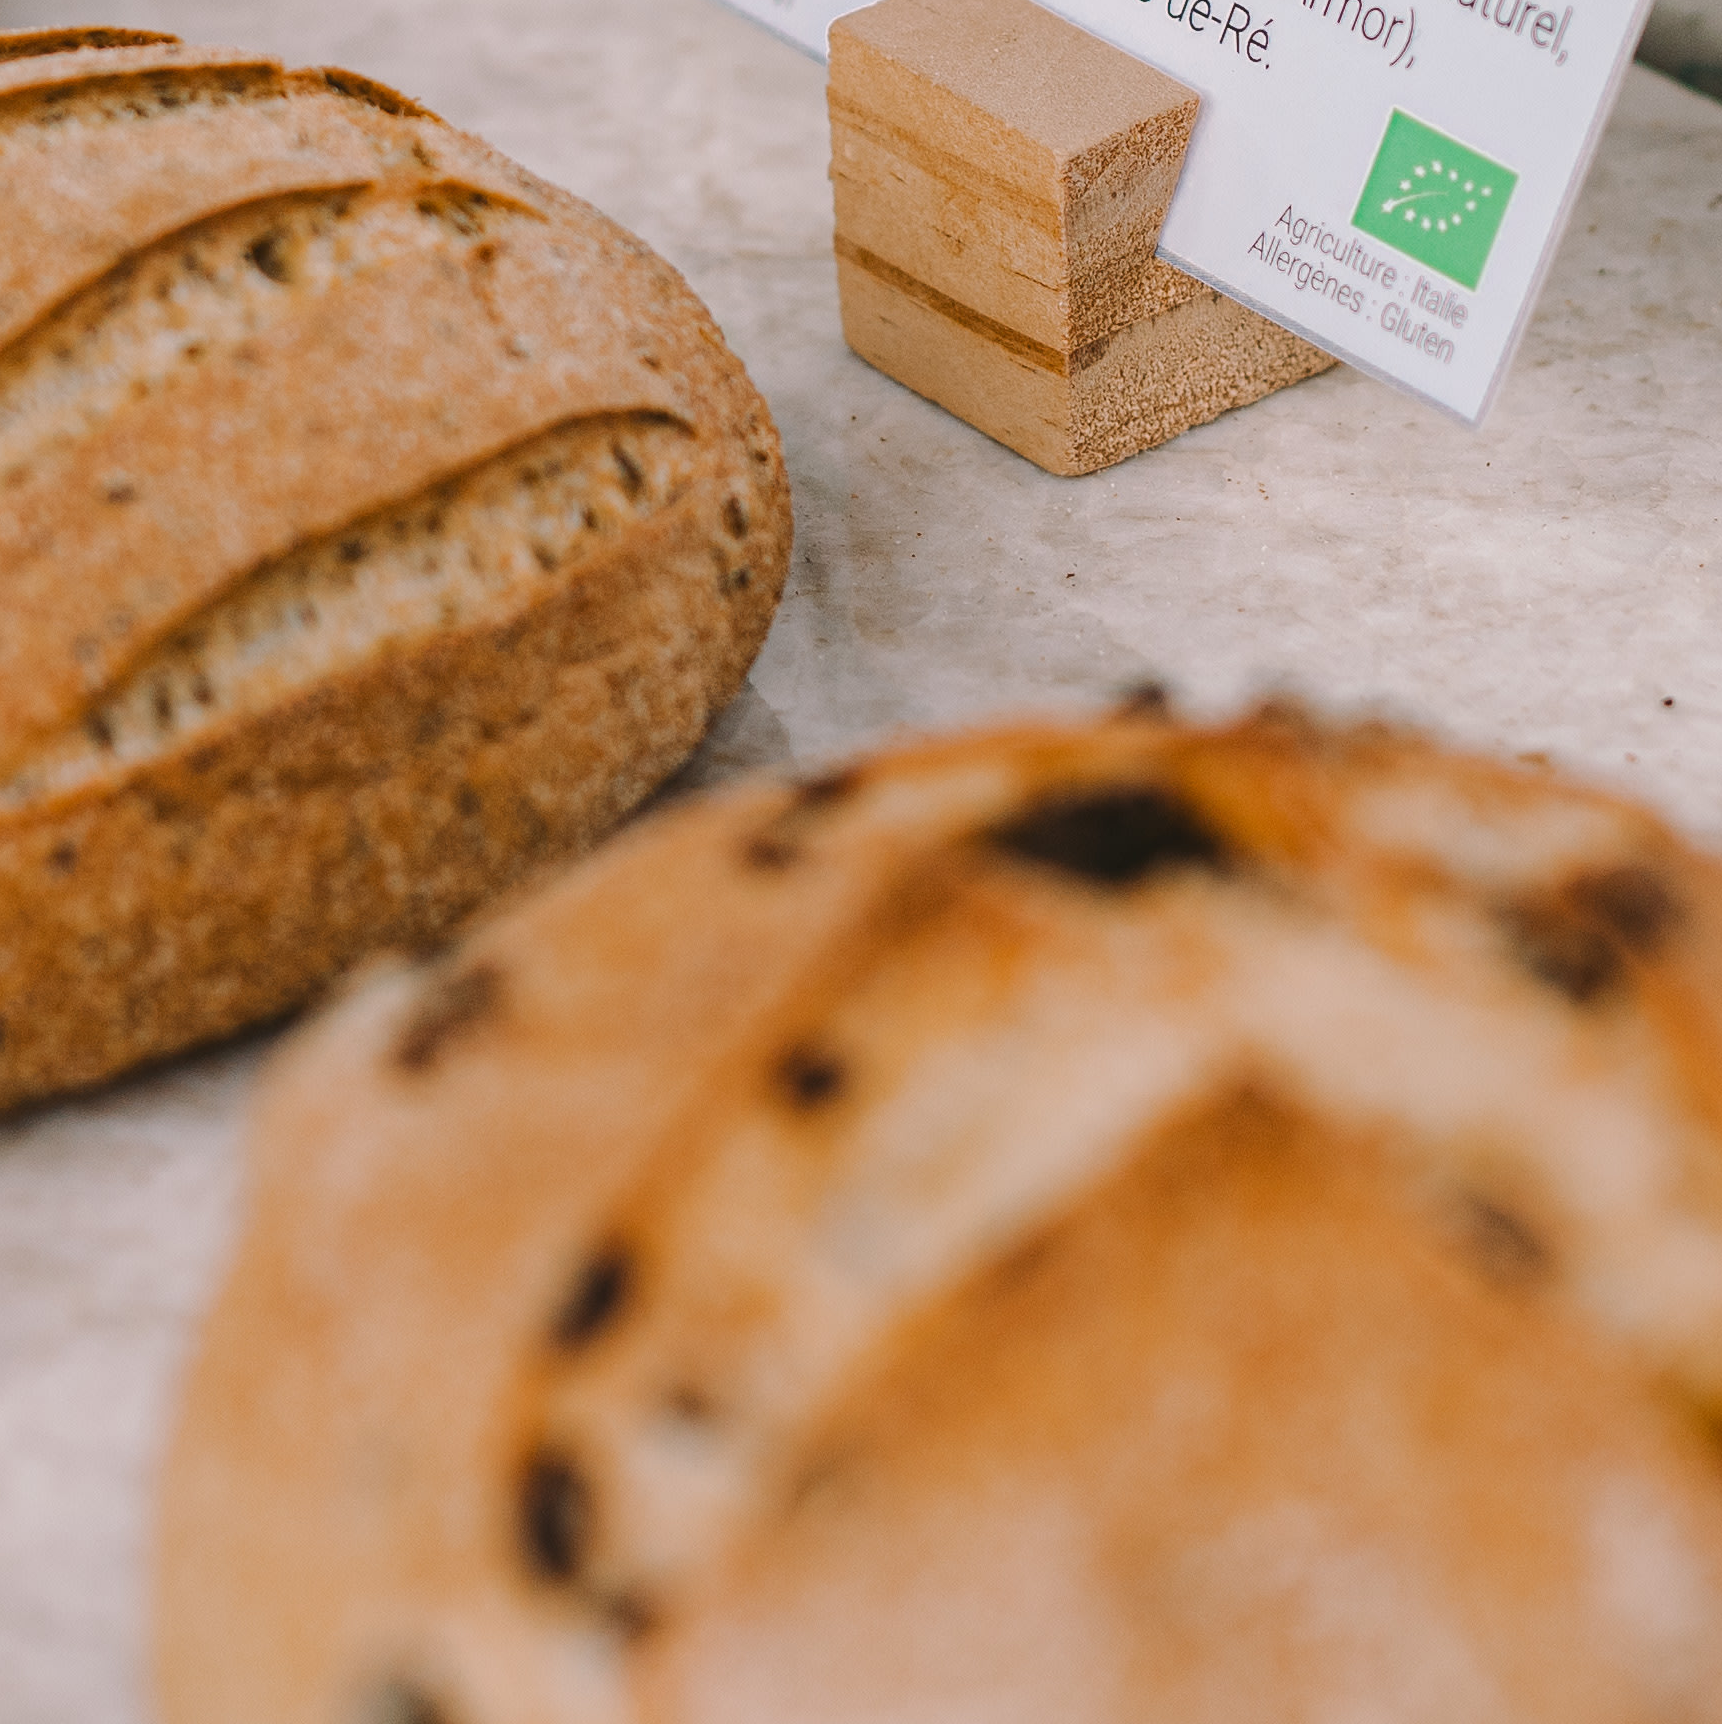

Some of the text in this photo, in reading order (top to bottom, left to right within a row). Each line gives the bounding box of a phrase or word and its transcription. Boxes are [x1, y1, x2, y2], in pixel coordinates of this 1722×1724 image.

[1247, 231, 1365, 313] Allergènes
[1379, 301, 1454, 364] Gluten
[1274, 204, 1397, 289] Agriculture
[1410, 275, 1468, 329] Italie
